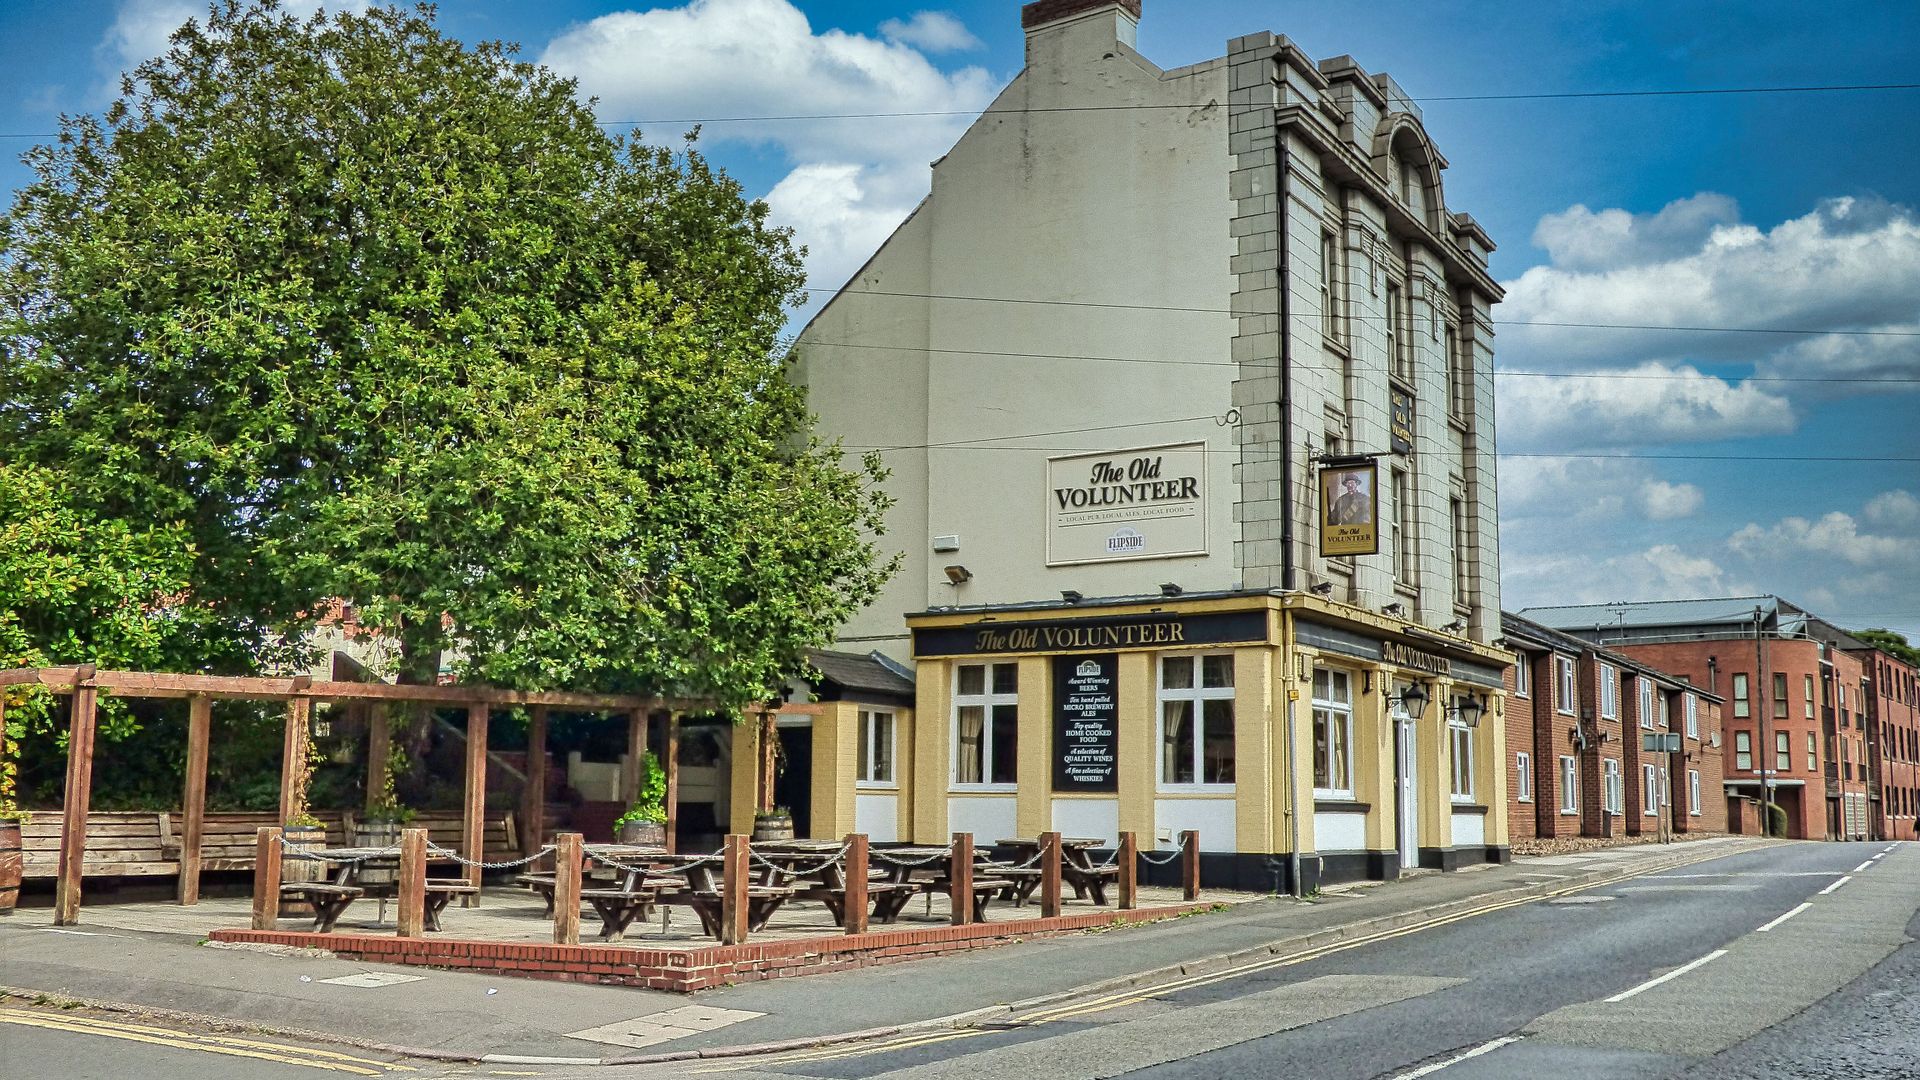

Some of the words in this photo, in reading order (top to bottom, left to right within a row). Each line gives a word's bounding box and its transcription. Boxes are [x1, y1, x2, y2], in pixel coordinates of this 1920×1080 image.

[1395, 411, 1406, 425] OLD
[1090, 461, 1124, 484] The
[1129, 456, 1162, 480] Old
[1054, 476, 1200, 510] VOLUNTEER
[1143, 508, 1164, 516] LOCAL
[1108, 536, 1143, 549] FLIPSIDE
[1327, 534, 1371, 543] VOLUNTEER
[976, 630, 1005, 650] The
[1008, 628, 1039, 649] Old
[1042, 622, 1185, 647] VOLUNTEER
[1383, 641, 1396, 662] The
[1396, 643, 1407, 664] Old
[1407, 646, 1451, 675] VOLUNTEER
[1087, 677, 1110, 685] Winning
[1084, 722, 1103, 730] quality
[1077, 747, 1099, 755] selection
[1064, 755, 1092, 763] QUALITY
[1105, 767, 1112, 775] of
